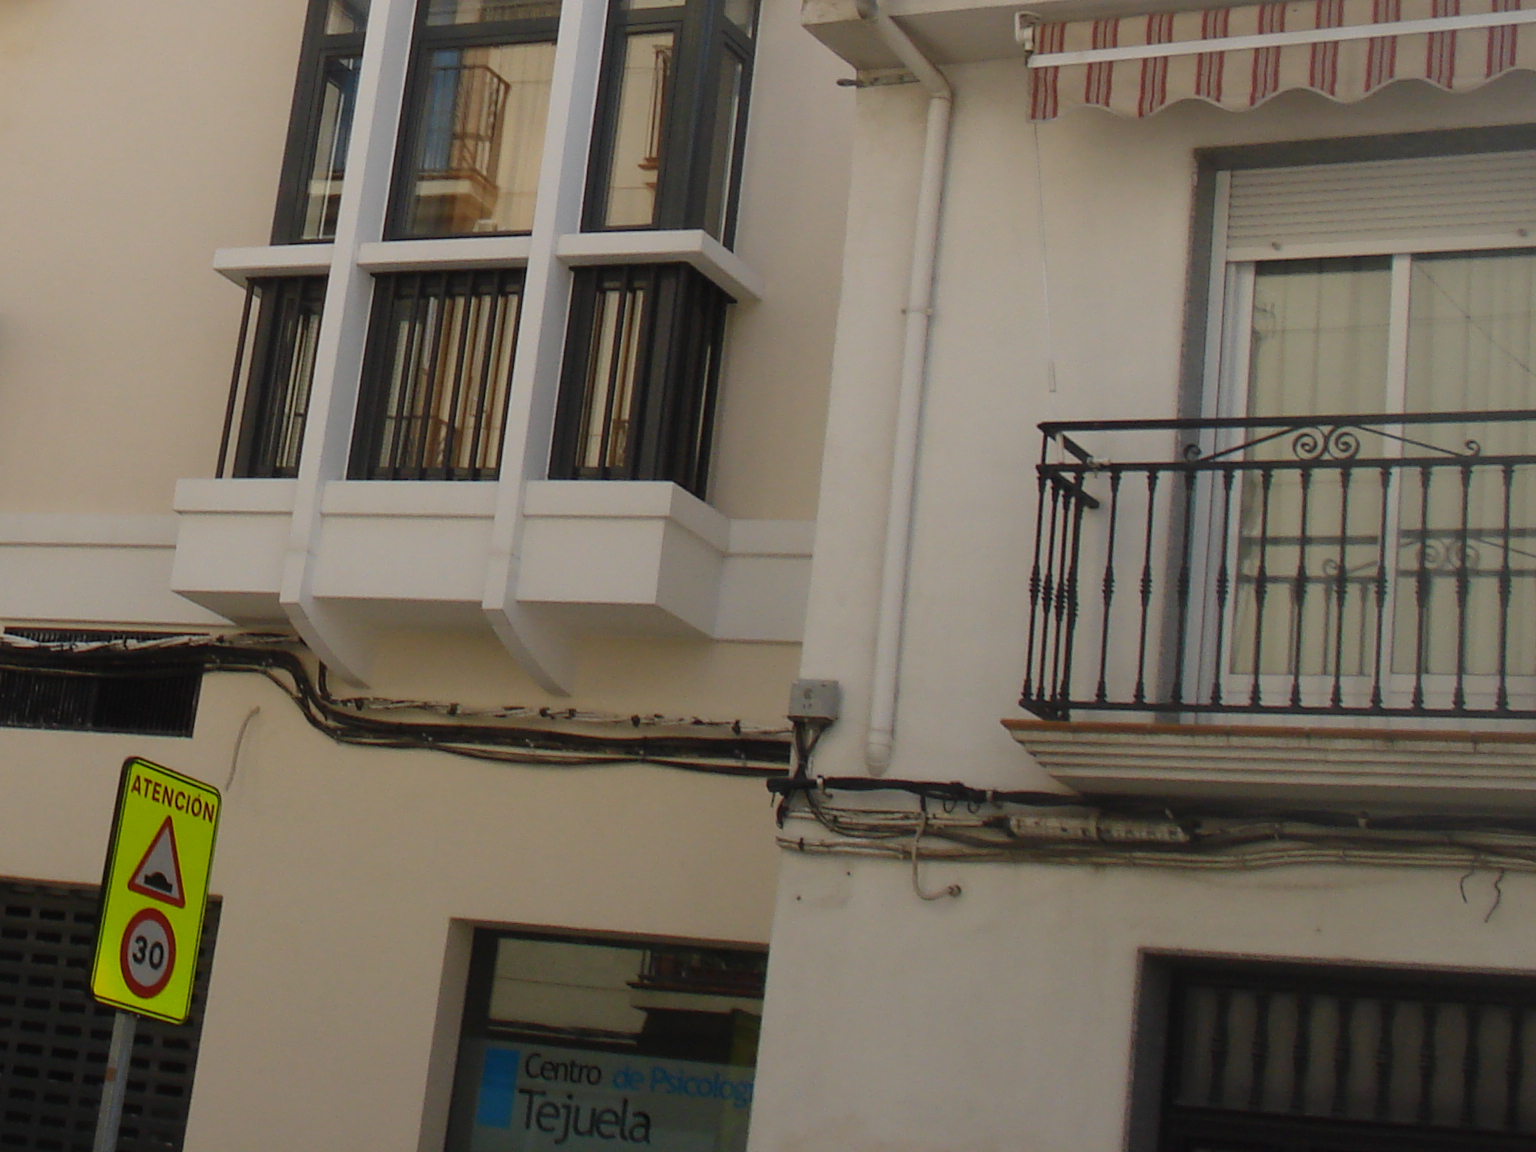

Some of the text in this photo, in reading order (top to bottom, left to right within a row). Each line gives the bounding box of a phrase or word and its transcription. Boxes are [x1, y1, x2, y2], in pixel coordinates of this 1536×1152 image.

[131, 774, 214, 823] ATENCIÓN
[132, 935, 164, 970] 30
[525, 1053, 602, 1086] Centro
[612, 1065, 644, 1091] de
[518, 1087, 652, 1145] Tejuela
